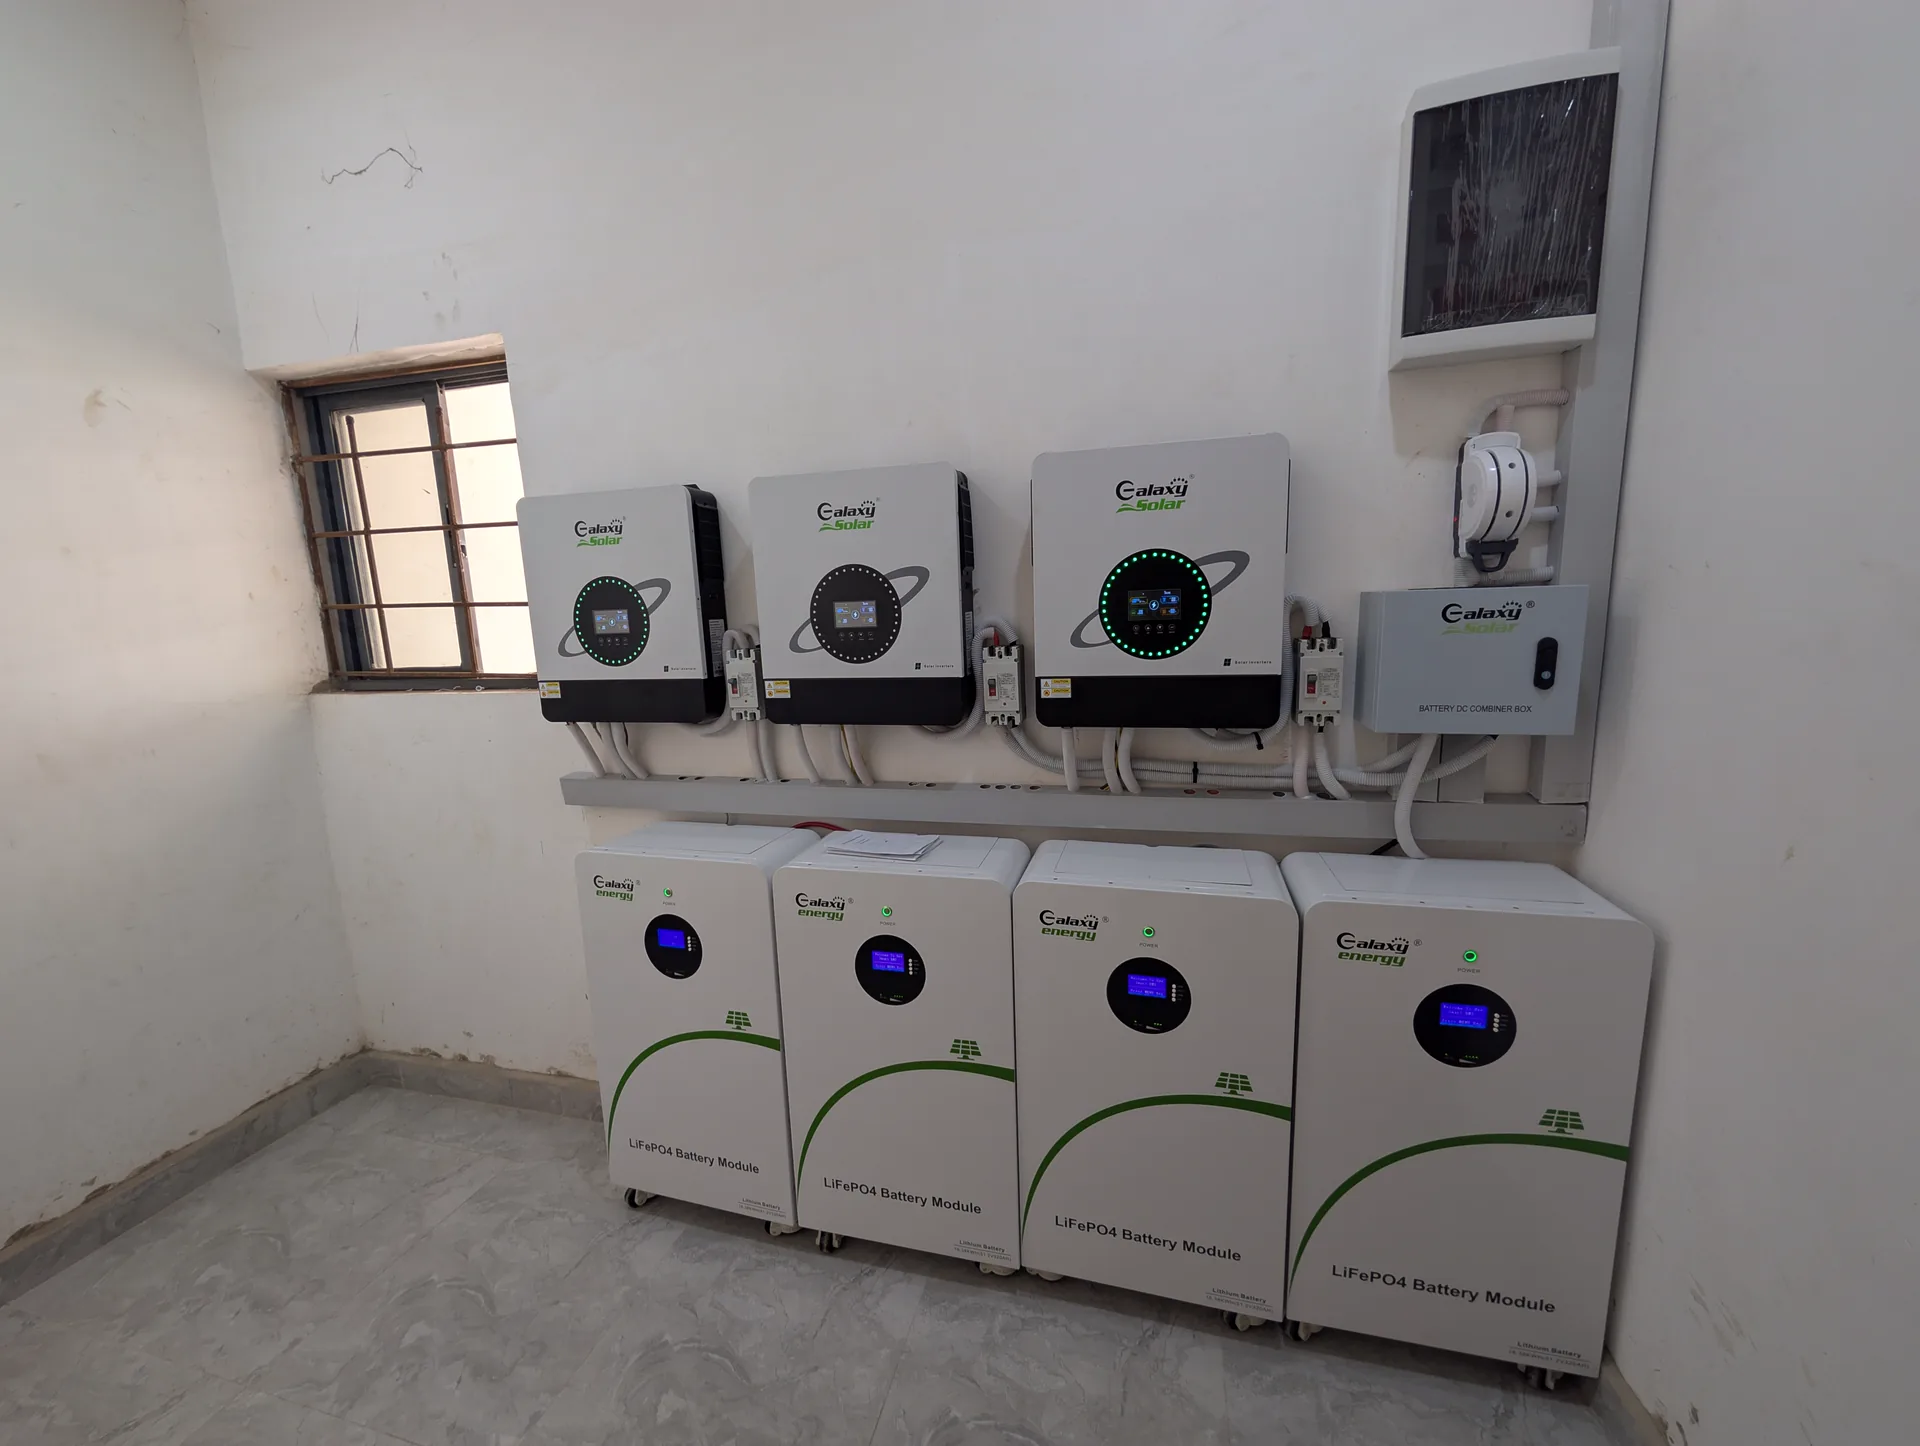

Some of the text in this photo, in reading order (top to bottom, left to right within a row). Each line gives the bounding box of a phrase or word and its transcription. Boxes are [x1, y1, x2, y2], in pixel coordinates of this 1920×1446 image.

[1116, 476, 1189, 500] Galaxy
[817, 500, 876, 520] Galaxy
[1136, 497, 1186, 512] Solar
[574, 518, 623, 537] Galaxy
[834, 519, 875, 531] Solar
[589, 535, 623, 547] Solar
[1441, 600, 1523, 623] Galaxy
[1463, 622, 1519, 635] Solar
[1419, 704, 1532, 713] BATTERY DC COMBINER BOX
[593, 875, 634, 891] Galaxy
[596, 889, 633, 901] energy
[795, 892, 845, 910] Galaxy
[797, 908, 844, 921] energy
[1039, 909, 1099, 930] Galaxy
[1041, 927, 1096, 942] energy
[1336, 932, 1409, 954] Galaxy
[1337, 951, 1406, 967] energy
[629, 1137, 760, 1174] LiFePO4 Battery Module
[823, 1177, 982, 1214] LiFePO4 Battery Module
[1055, 1215, 1242, 1261] LiFePO4 Battery Module
[1331, 1264, 1556, 1313] LiFePO4 Battery Module
